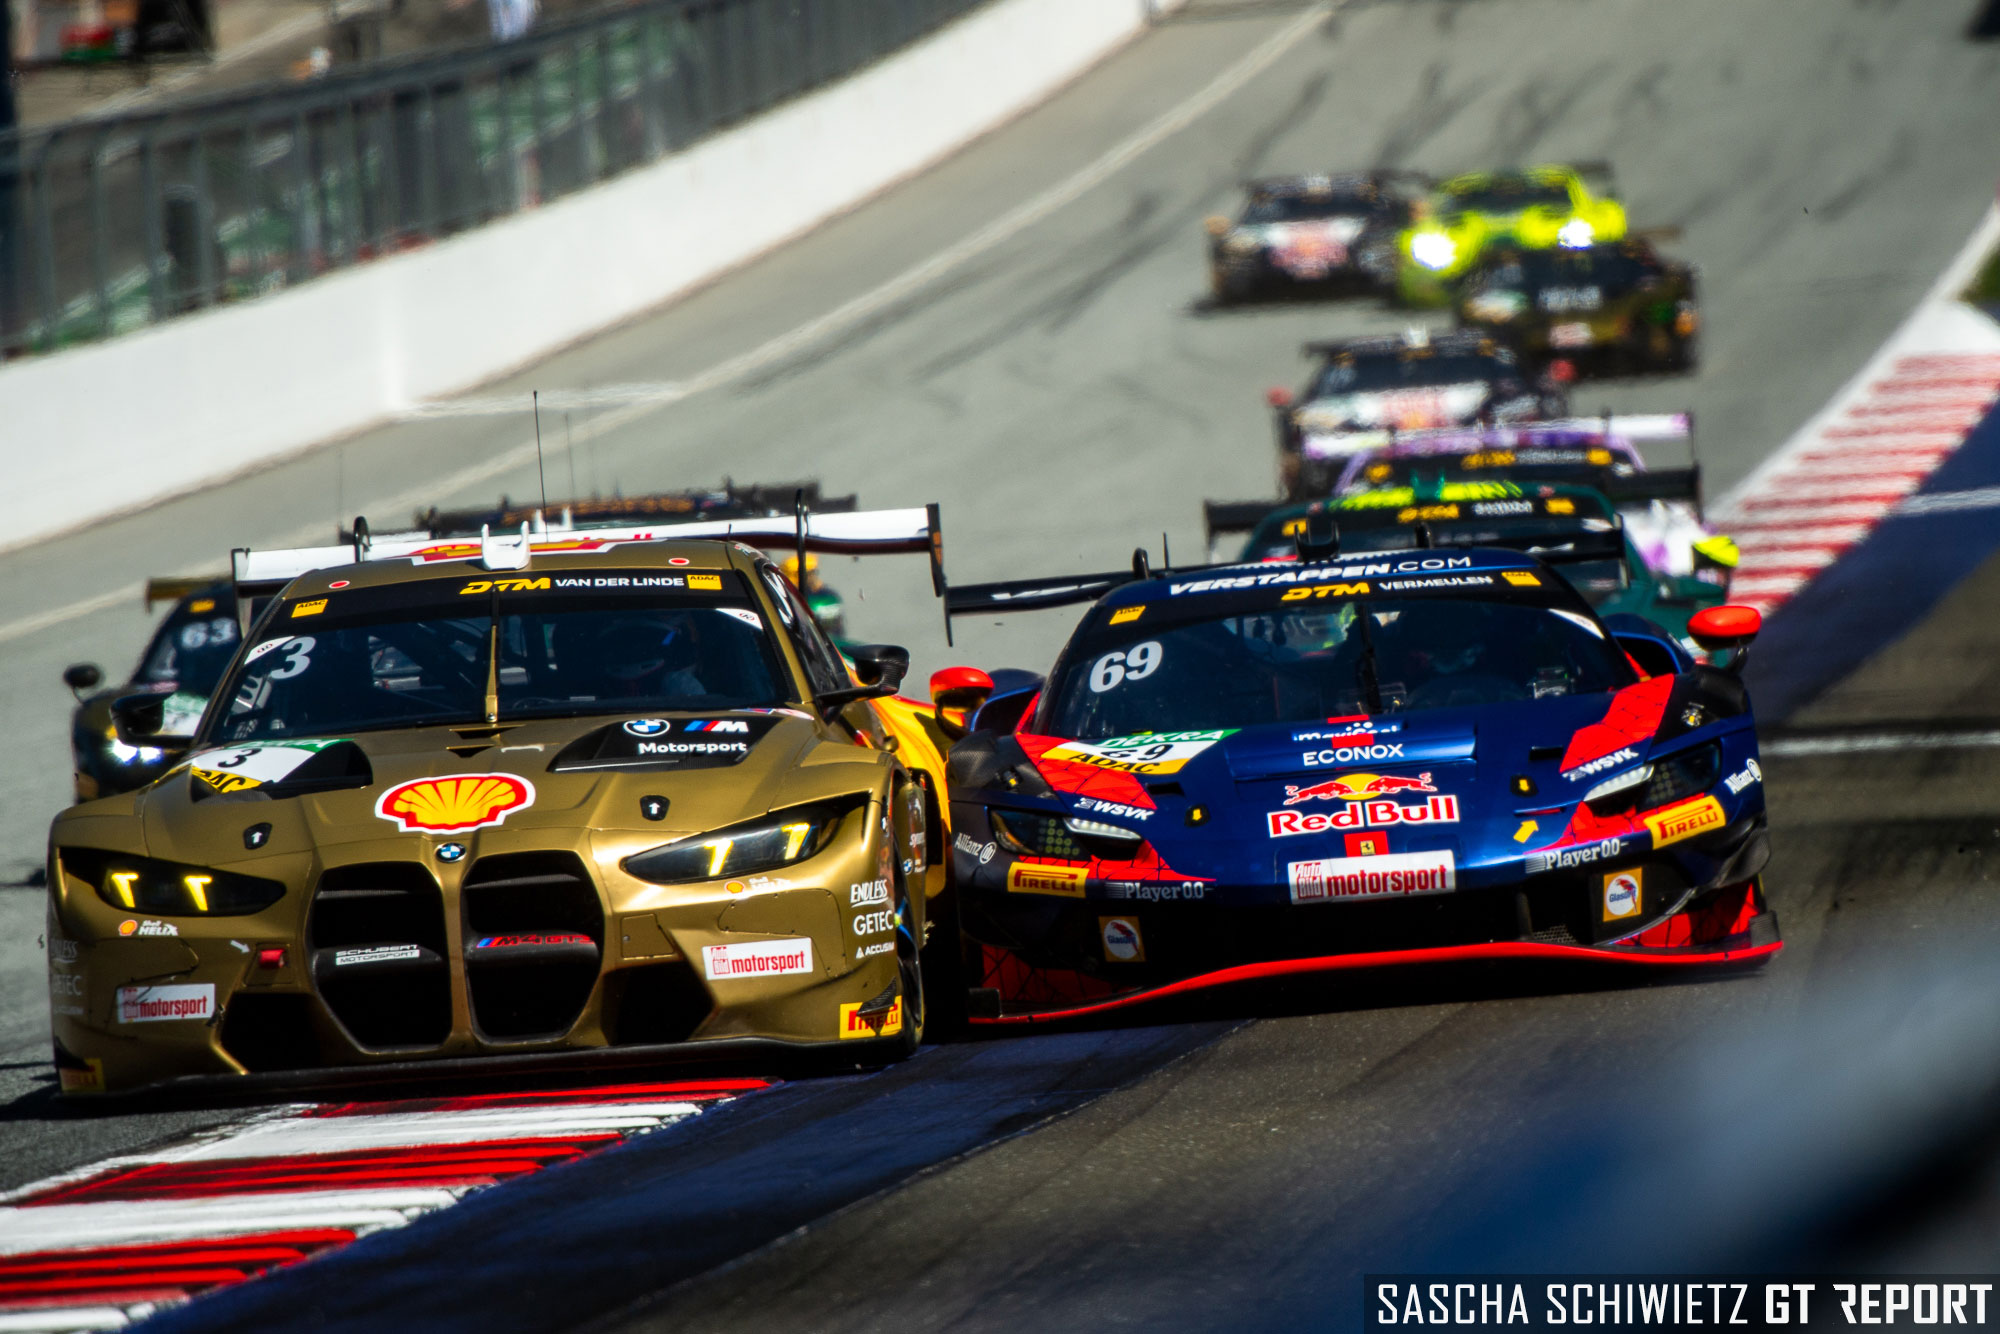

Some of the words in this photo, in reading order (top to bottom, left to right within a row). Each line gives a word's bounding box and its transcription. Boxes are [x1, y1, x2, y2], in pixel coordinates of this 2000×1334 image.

[459, 577, 551, 595] DTM
[555, 577, 591, 587] VAN
[595, 577, 630, 587] DER
[633, 577, 685, 587] LINDE
[1169, 556, 1472, 596] VERSTAPPEN.COM
[1378, 575, 1494, 591] VERMEULEN
[1281, 582, 1371, 601] DTM
[270, 636, 316, 680] 3
[1089, 642, 1163, 694] 69
[638, 742, 747, 755] Motorsport
[1102, 730, 1224, 748] DEKRA
[217, 748, 262, 768] 3
[1069, 753, 1160, 773] ADAC
[1302, 744, 1404, 766] ECONOX
[1578, 747, 1639, 775] WSVK
[1093, 801, 1155, 821] WSVK
[1267, 801, 1364, 838] Red
[1365, 795, 1460, 827] Bull
[1656, 804, 1719, 840] PIRELLI
[954, 832, 983, 856] Allianz
[850, 879, 888, 904] ENDLESS
[1014, 869, 1078, 892] PIRELLI
[1326, 865, 1447, 897] motorsport
[138, 923, 179, 936] HELIX
[853, 910, 894, 936] GETEC
[336, 944, 418, 956] SCHUBERT
[340, 951, 415, 964] MOTORSPORT
[731, 950, 805, 973] motorsport
[140, 995, 207, 1018] motorsport
